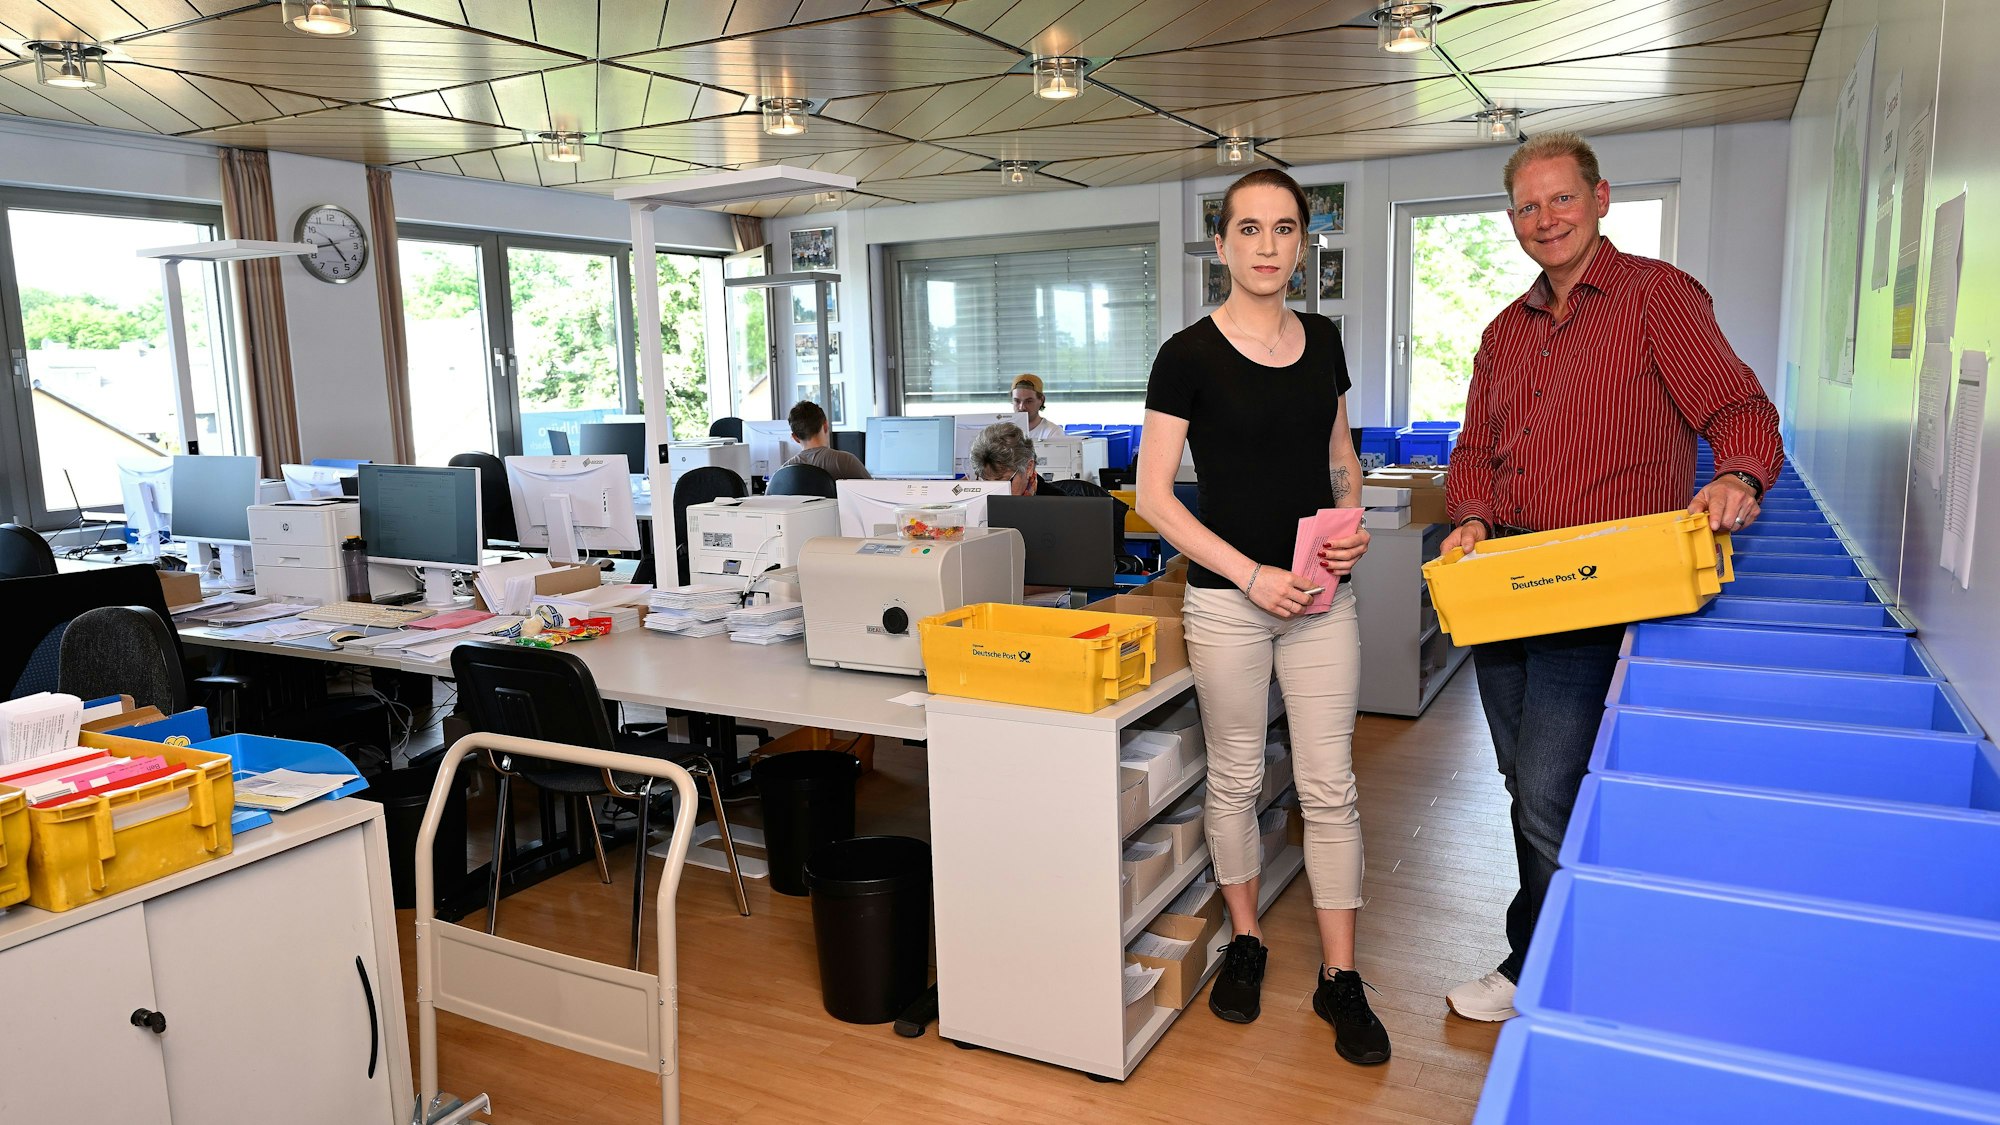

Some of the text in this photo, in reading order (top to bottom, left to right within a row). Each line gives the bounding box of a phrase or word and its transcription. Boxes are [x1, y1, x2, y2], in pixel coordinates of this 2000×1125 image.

[1512, 577, 1554, 590] Deutsche
[1556, 573, 1576, 582] Post
[972, 648, 1017, 660] Deutsche Post
